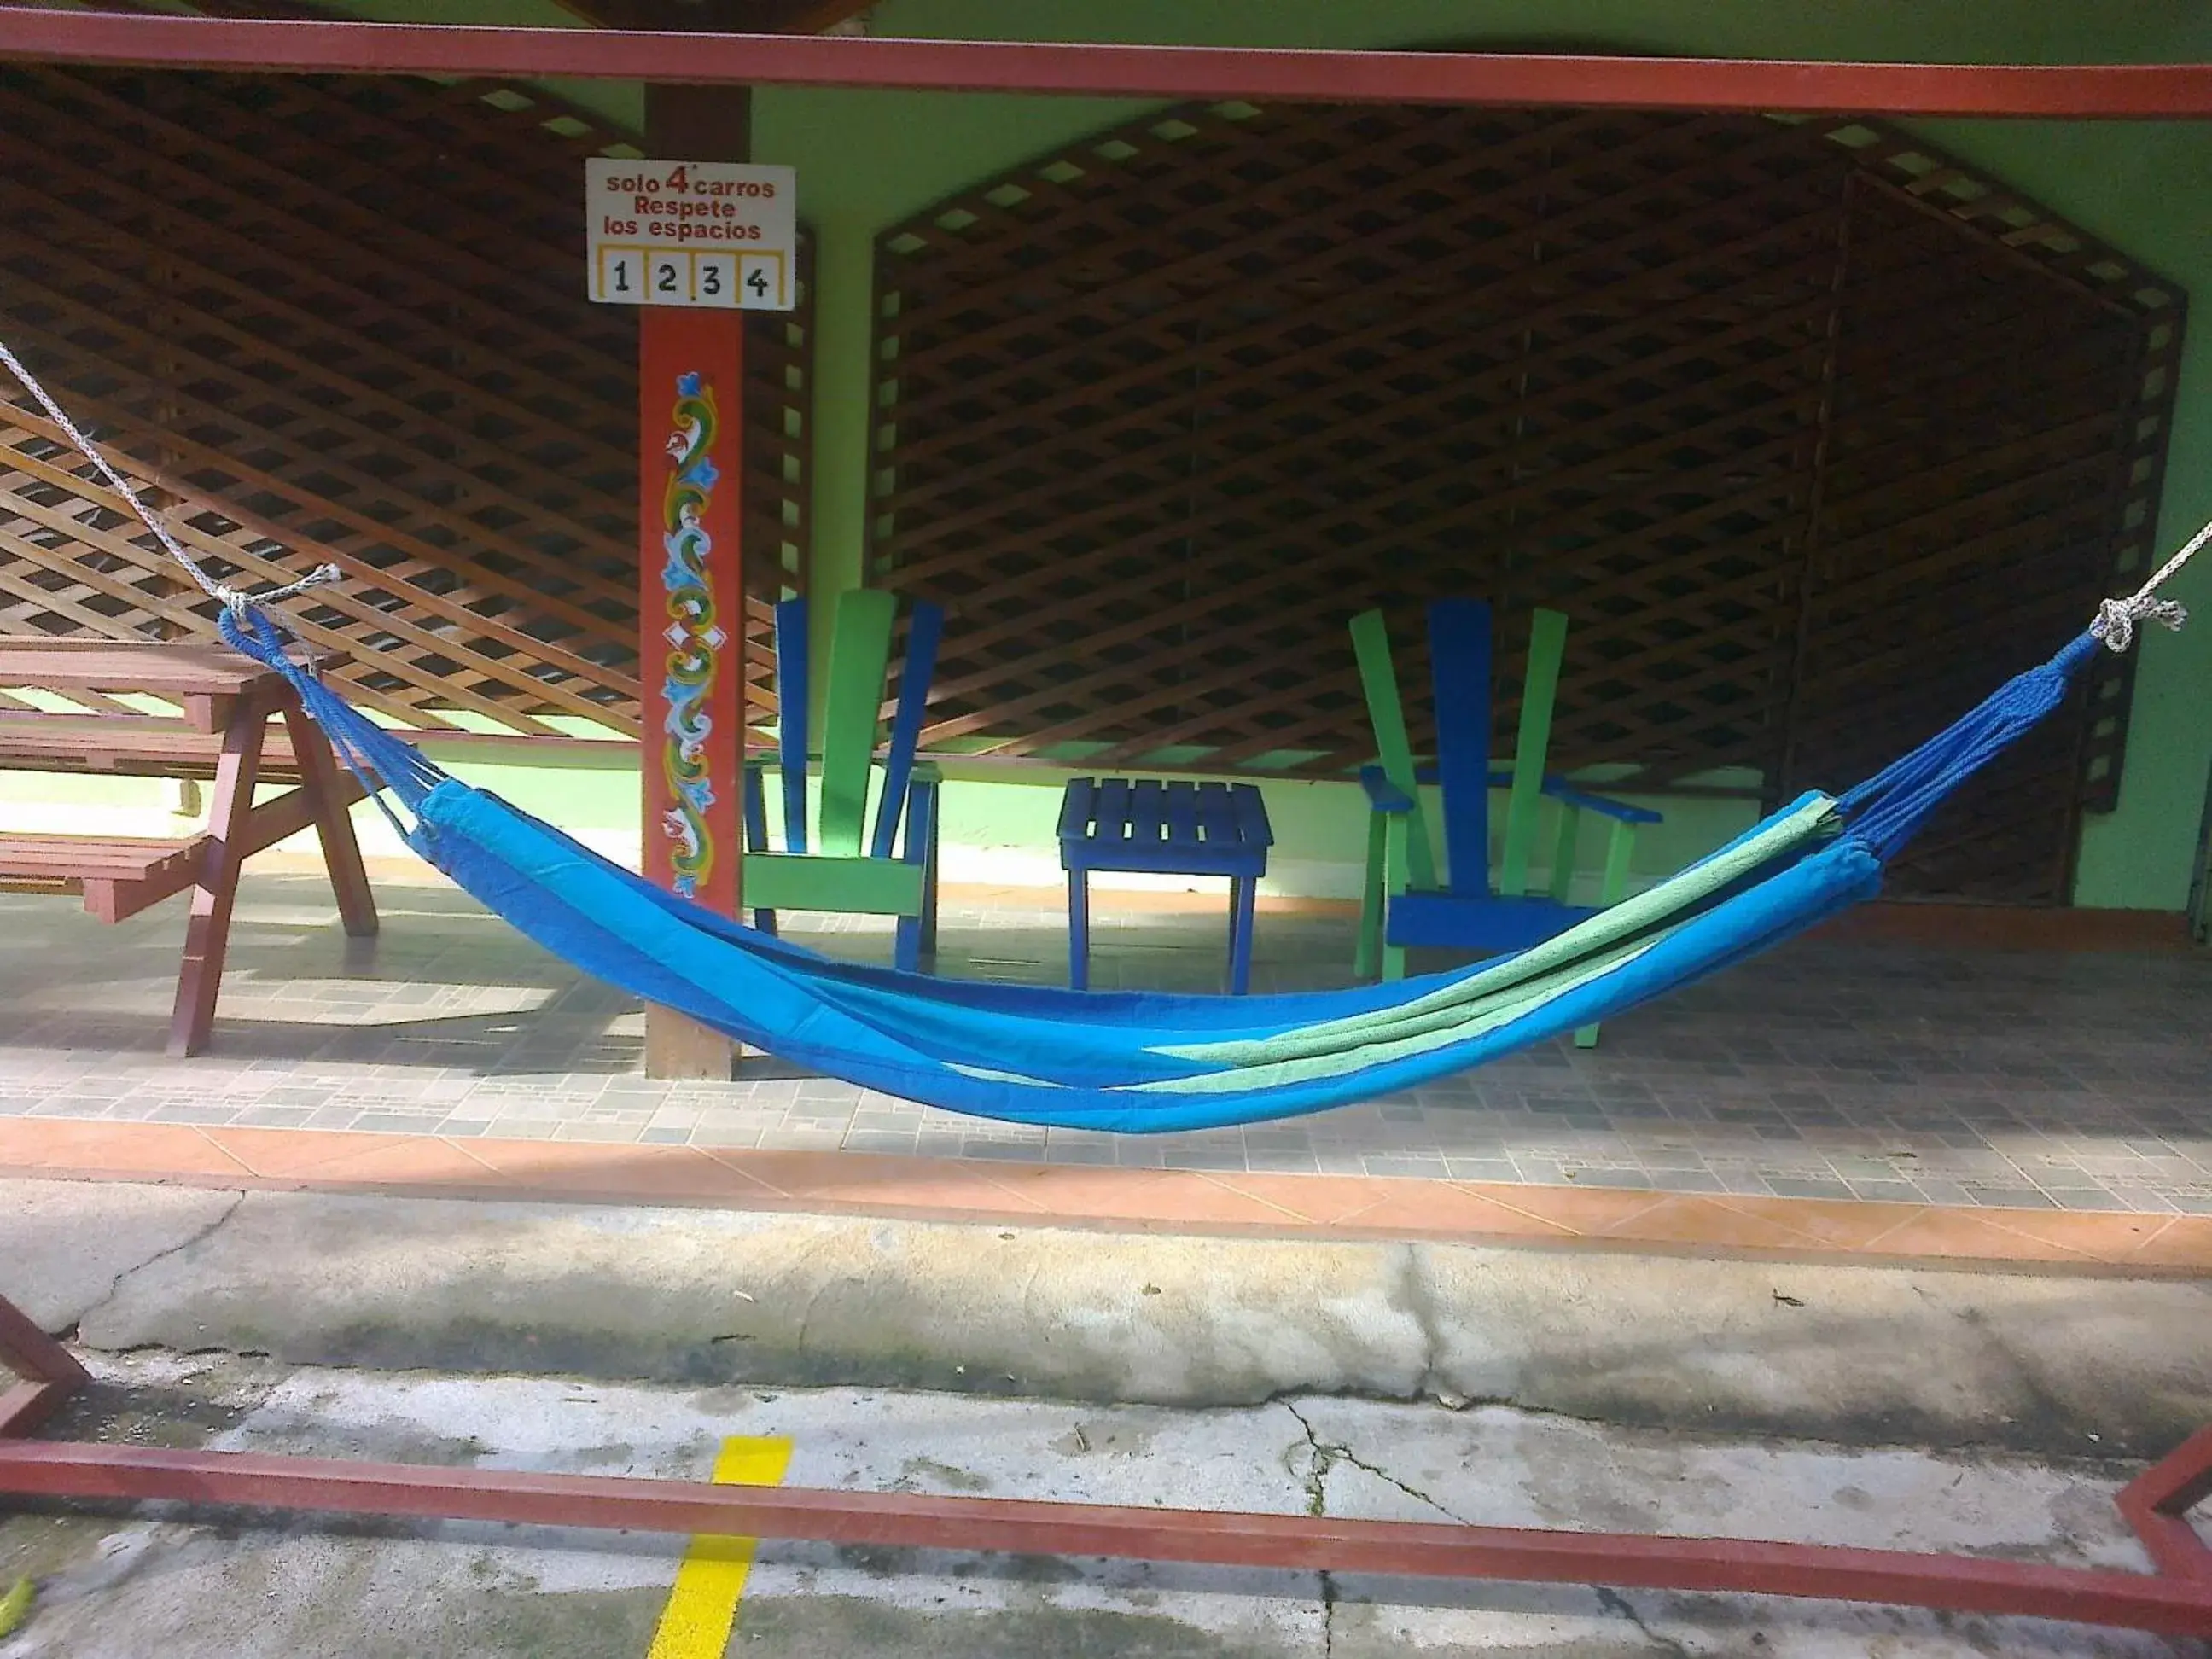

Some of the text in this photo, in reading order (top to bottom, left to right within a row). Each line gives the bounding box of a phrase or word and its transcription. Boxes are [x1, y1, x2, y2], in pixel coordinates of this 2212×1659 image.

[606, 165, 775, 198] solo 4 carros
[634, 195, 736, 220] Respete
[603, 216, 761, 242] los espacios
[614, 260, 768, 297] 1 2 3 4
